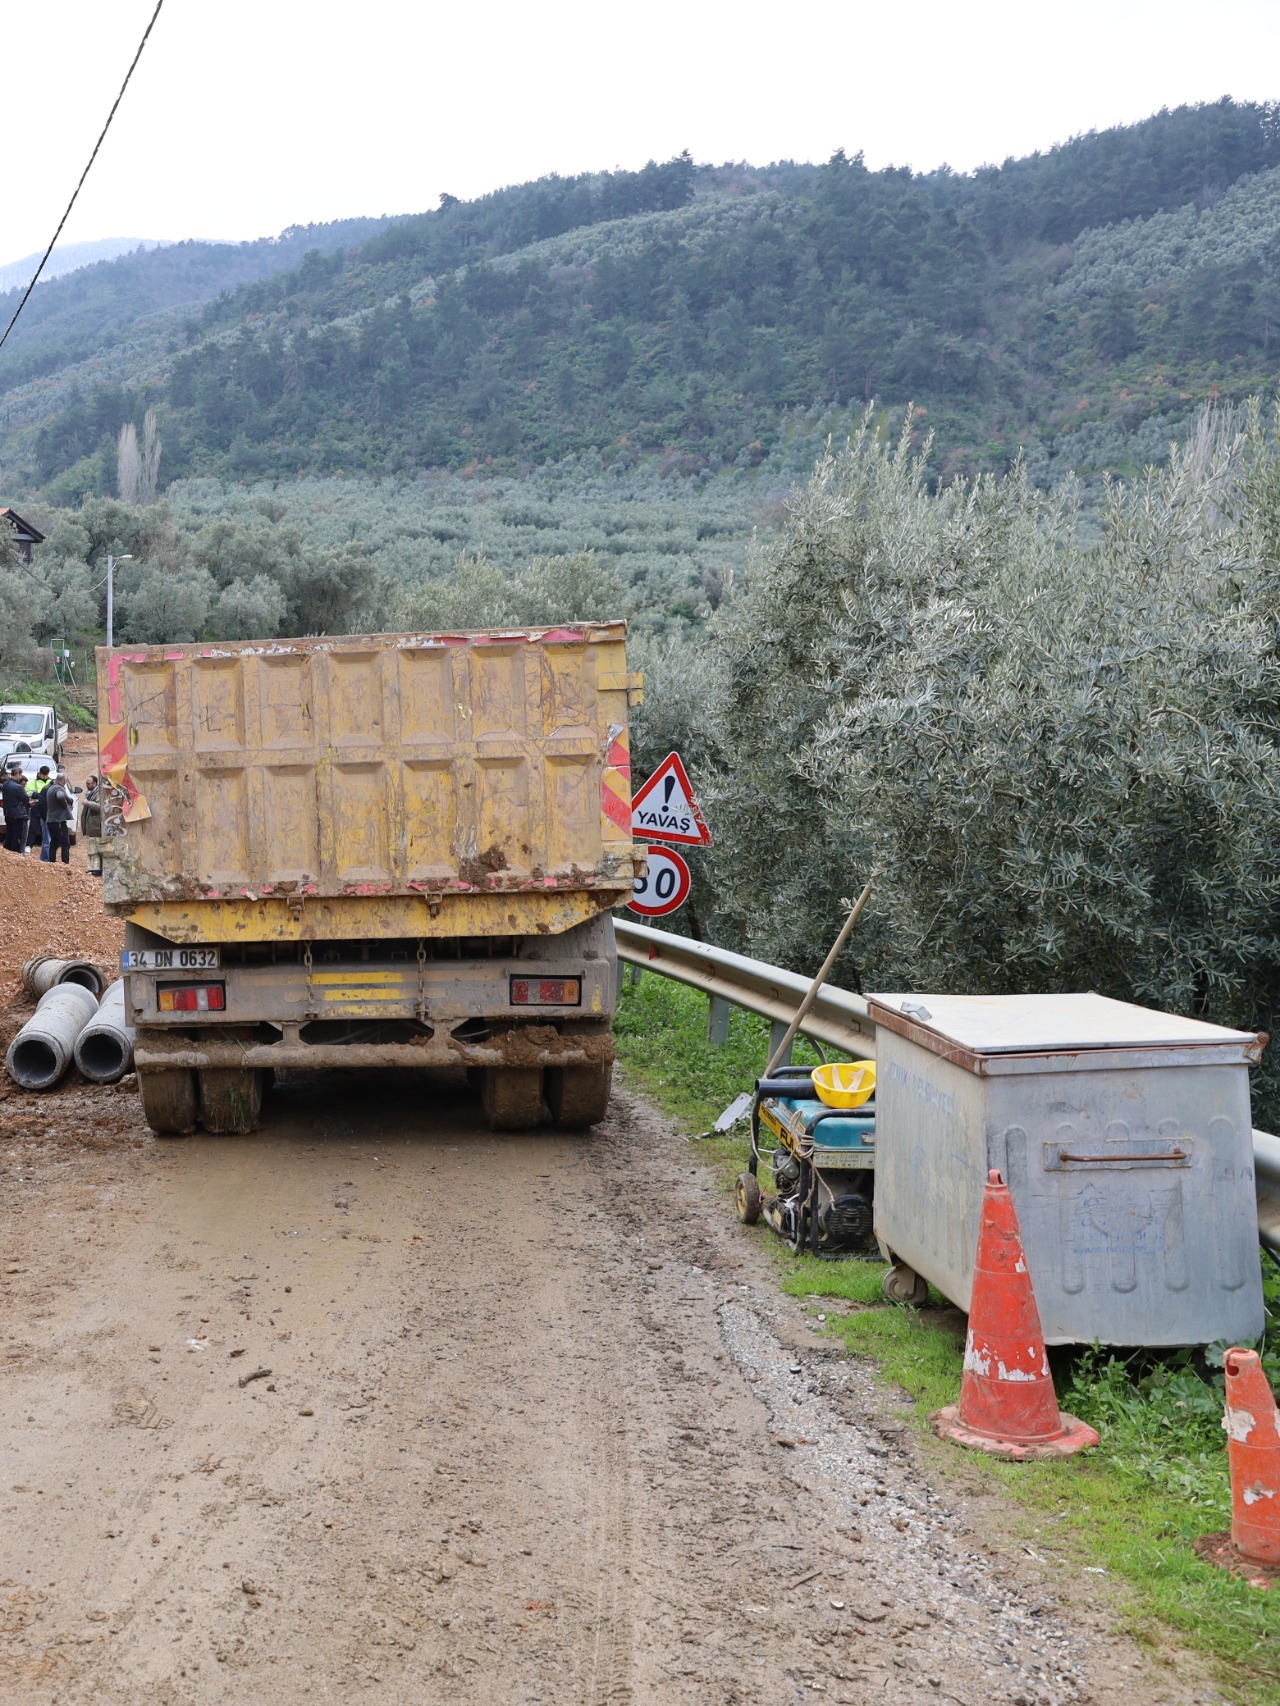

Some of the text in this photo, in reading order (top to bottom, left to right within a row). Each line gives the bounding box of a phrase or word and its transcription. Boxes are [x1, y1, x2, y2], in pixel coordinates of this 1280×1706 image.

[638, 811, 691, 834] YAVAŞ
[130, 950, 216, 968] 34 DN 0632
